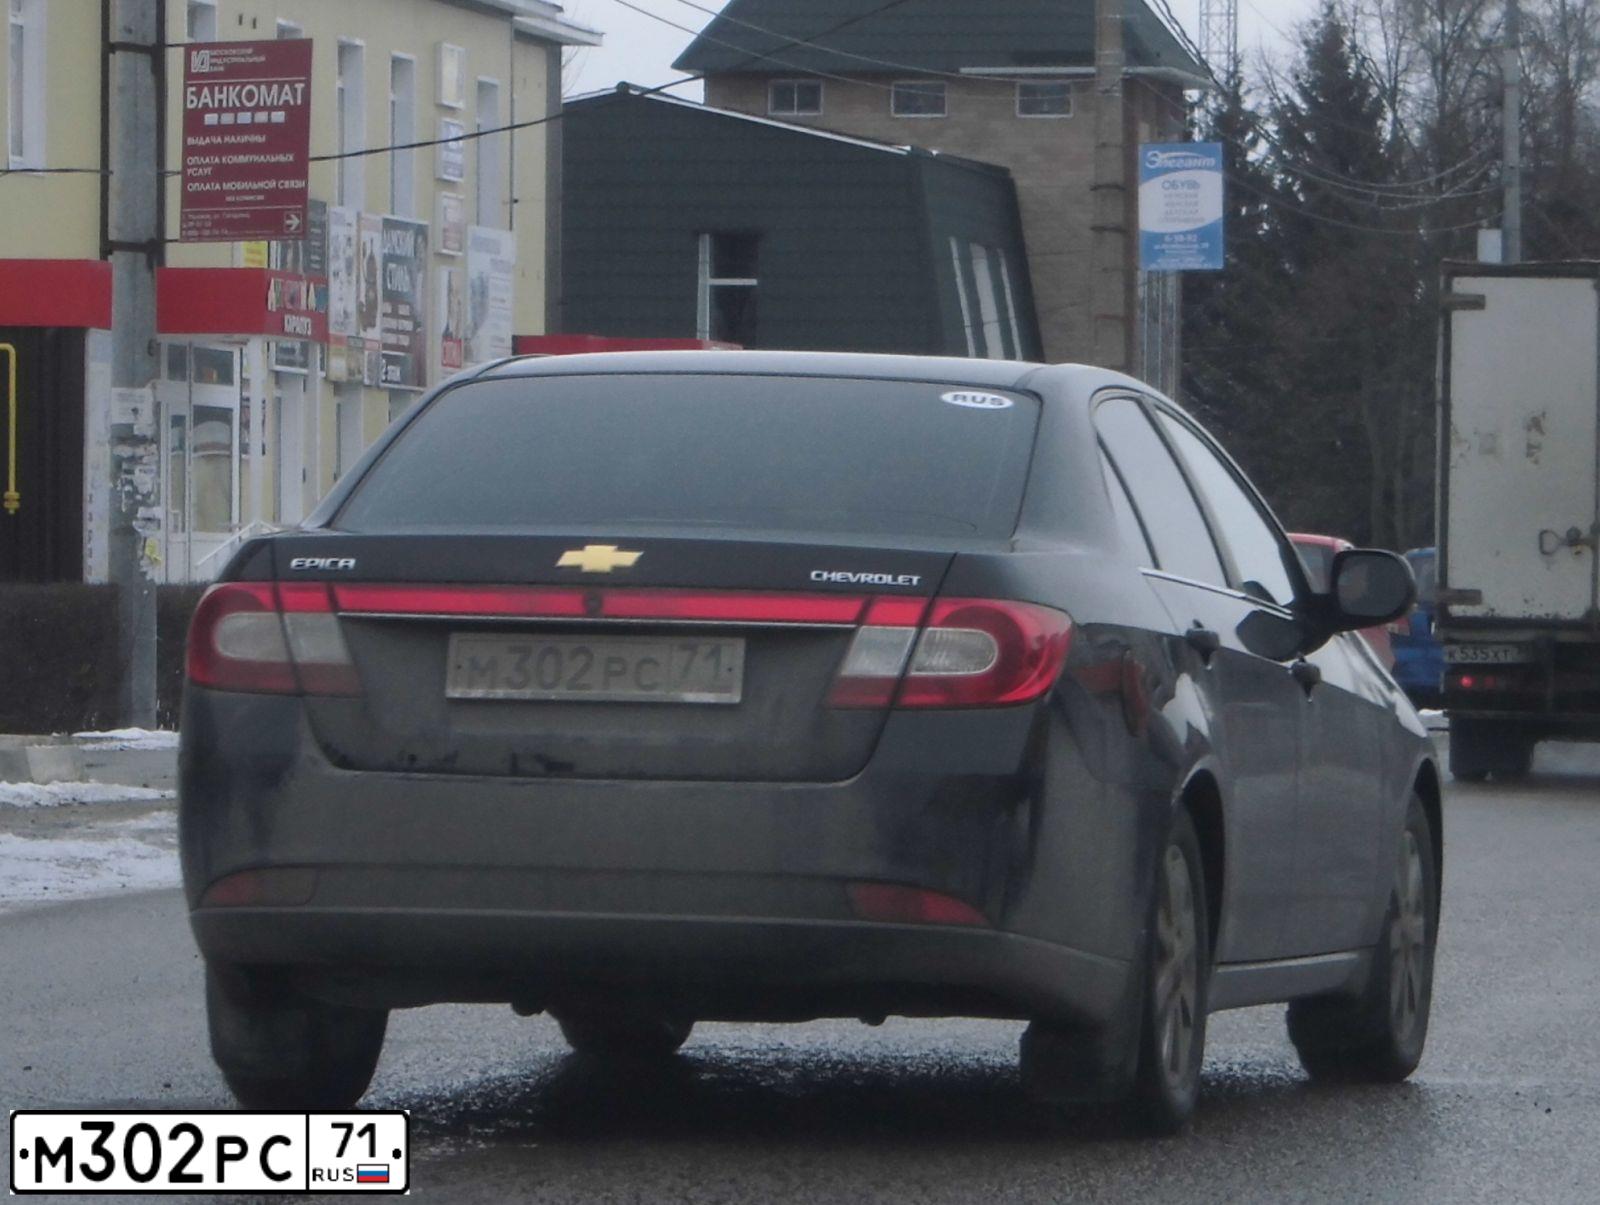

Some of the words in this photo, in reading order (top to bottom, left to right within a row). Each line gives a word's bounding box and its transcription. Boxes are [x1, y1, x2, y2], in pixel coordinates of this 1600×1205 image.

[186, 83, 305, 109] БАНКОМАТ
[187, 135, 222, 146] ВЫДАЧА
[187, 156, 220, 166] ОПЛАТА
[222, 153, 294, 165] КОММУНАЛЬНЫХ
[187, 167, 212, 177] УСЛУГ
[187, 182, 220, 192] ОПЛАТА
[222, 179, 276, 191] МОБИЛЬНОЙ
[277, 180, 306, 190] СВЯЗИ
[1161, 179, 1201, 191] ОБУВЬ
[952, 393, 1005, 406] RUS
[289, 557, 357, 570] EPICA
[810, 569, 921, 586] CHEVROLET
